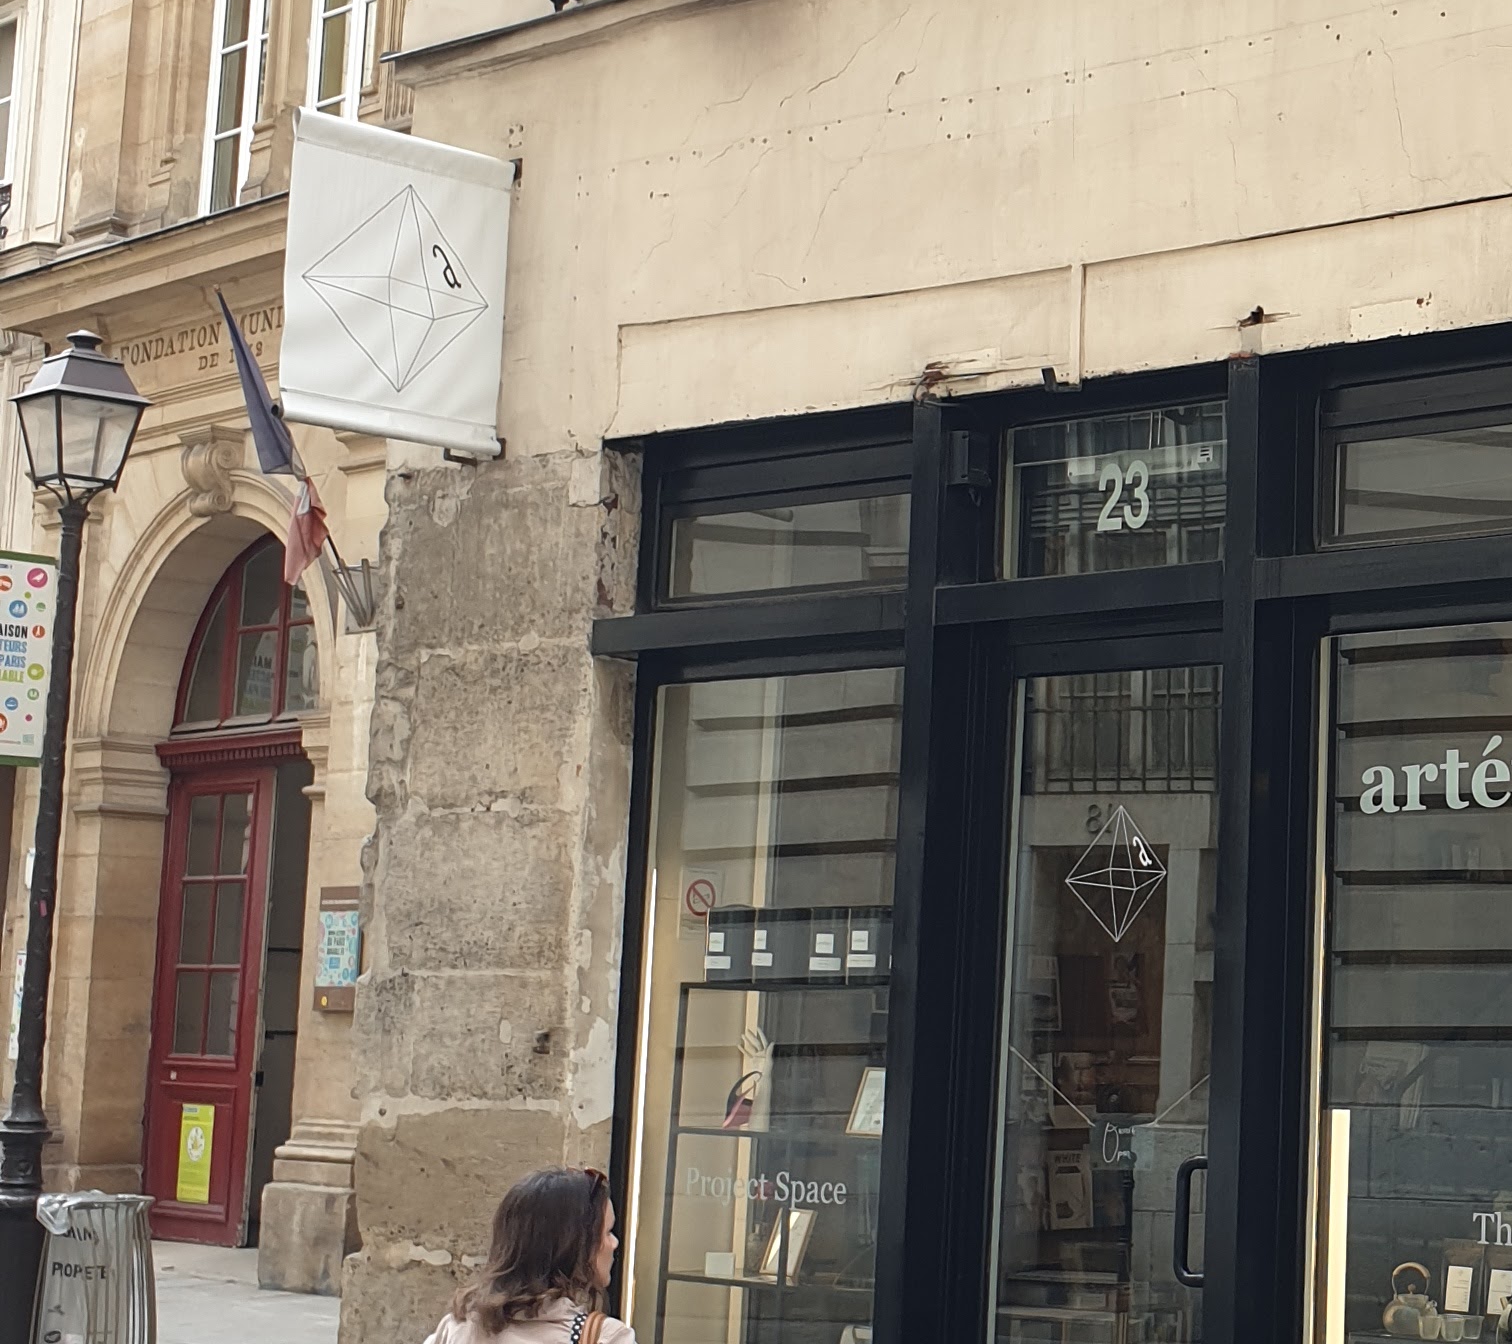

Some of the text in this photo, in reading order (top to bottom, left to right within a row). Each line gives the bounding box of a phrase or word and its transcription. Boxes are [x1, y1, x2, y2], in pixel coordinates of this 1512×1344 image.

[120, 321, 222, 366] FONDATION
[198, 353, 219, 371] DE
[1097, 460, 1150, 531] 23
[0, 654, 26, 668] PARIS
[0, 669, 25, 683] ABLE
[687, 1167, 847, 1209] Project Space
